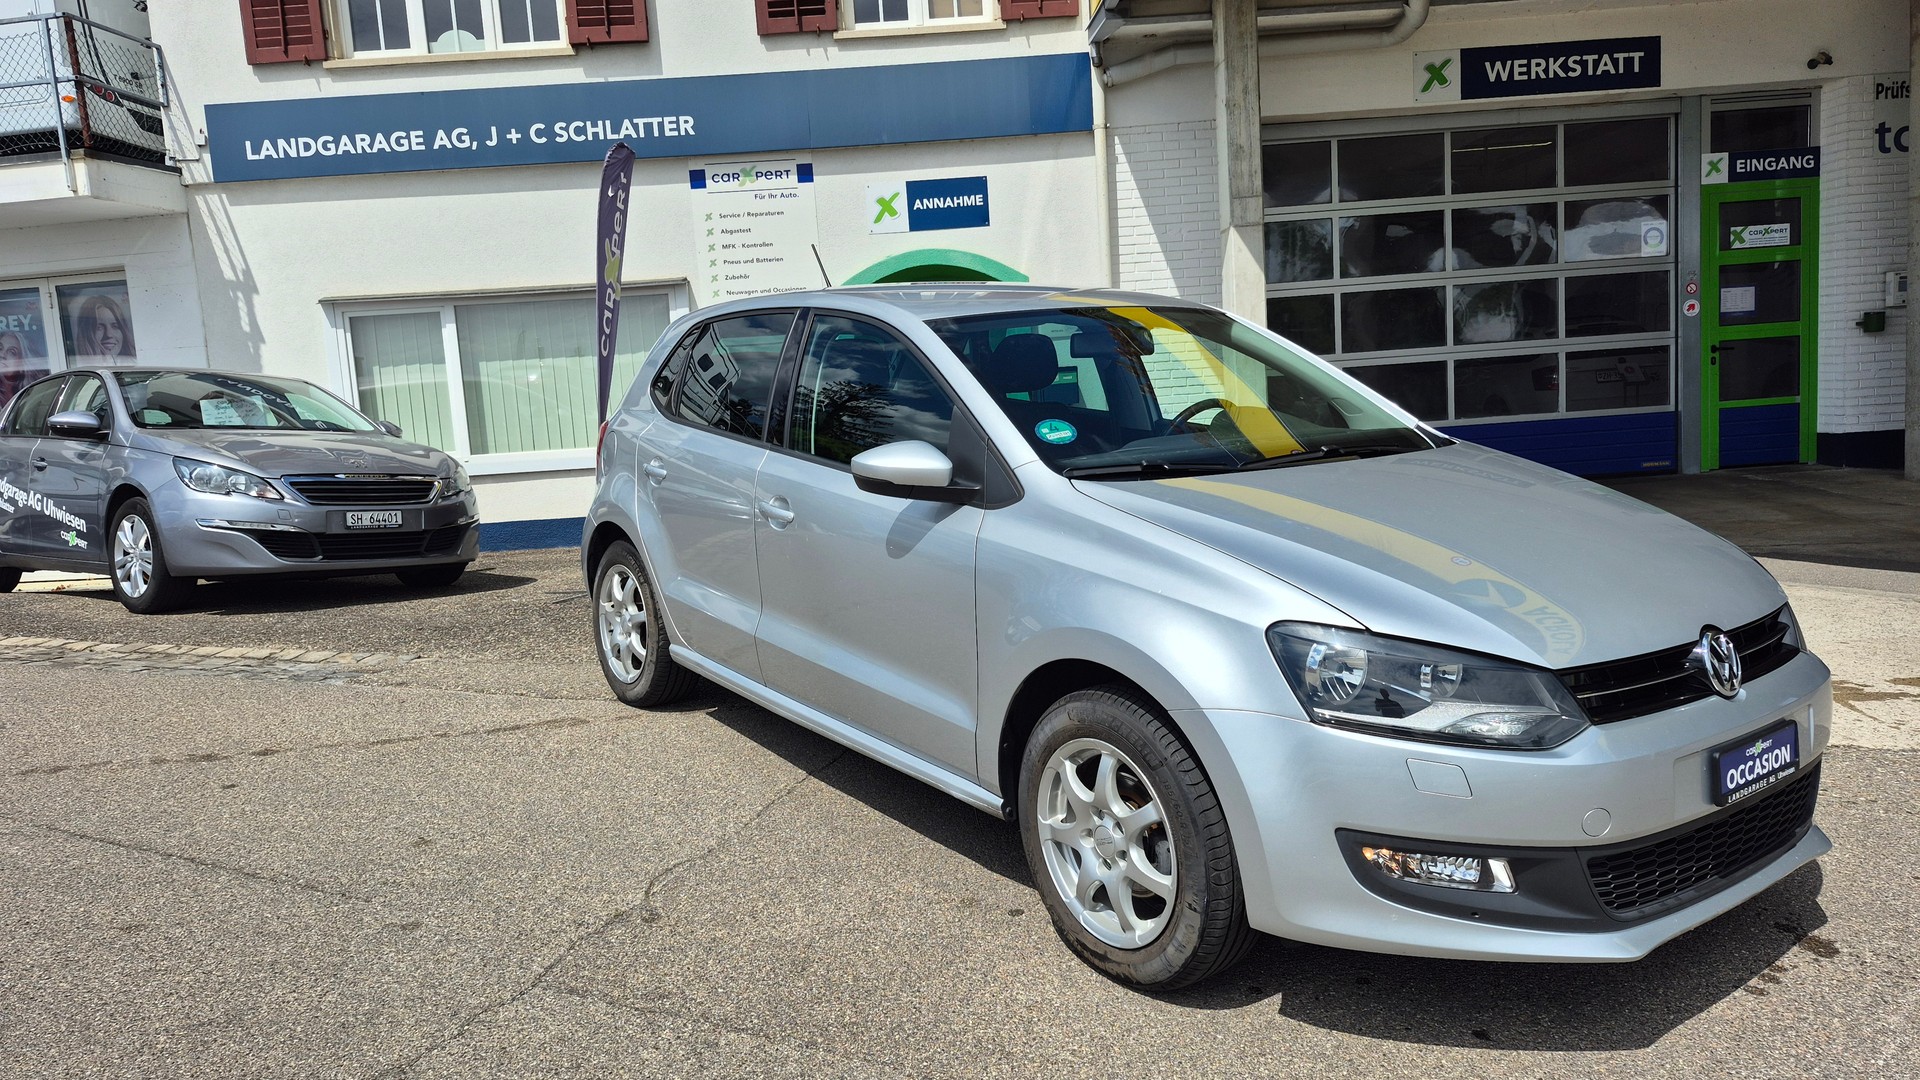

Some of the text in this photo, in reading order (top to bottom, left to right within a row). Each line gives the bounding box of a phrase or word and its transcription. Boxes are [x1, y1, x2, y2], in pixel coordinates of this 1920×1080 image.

[1484, 51, 1645, 83] WERKSTATT
[244, 115, 696, 161] LANDGARAGE AG, J + C SCHLATTER
[1736, 155, 1815, 173] EINGANG
[747, 210, 785, 218] Reparaturen
[913, 194, 984, 211] ANNAHME
[742, 241, 774, 249] Kontrollen
[28, 490, 42, 511] AG
[43, 496, 87, 532] Uhwiesen
[350, 512, 399, 525] SH 64401
[1726, 743, 1791, 790] OCCASION
[1728, 779, 1767, 803] LANDGARAGE
[1768, 775, 1776, 784] AG
